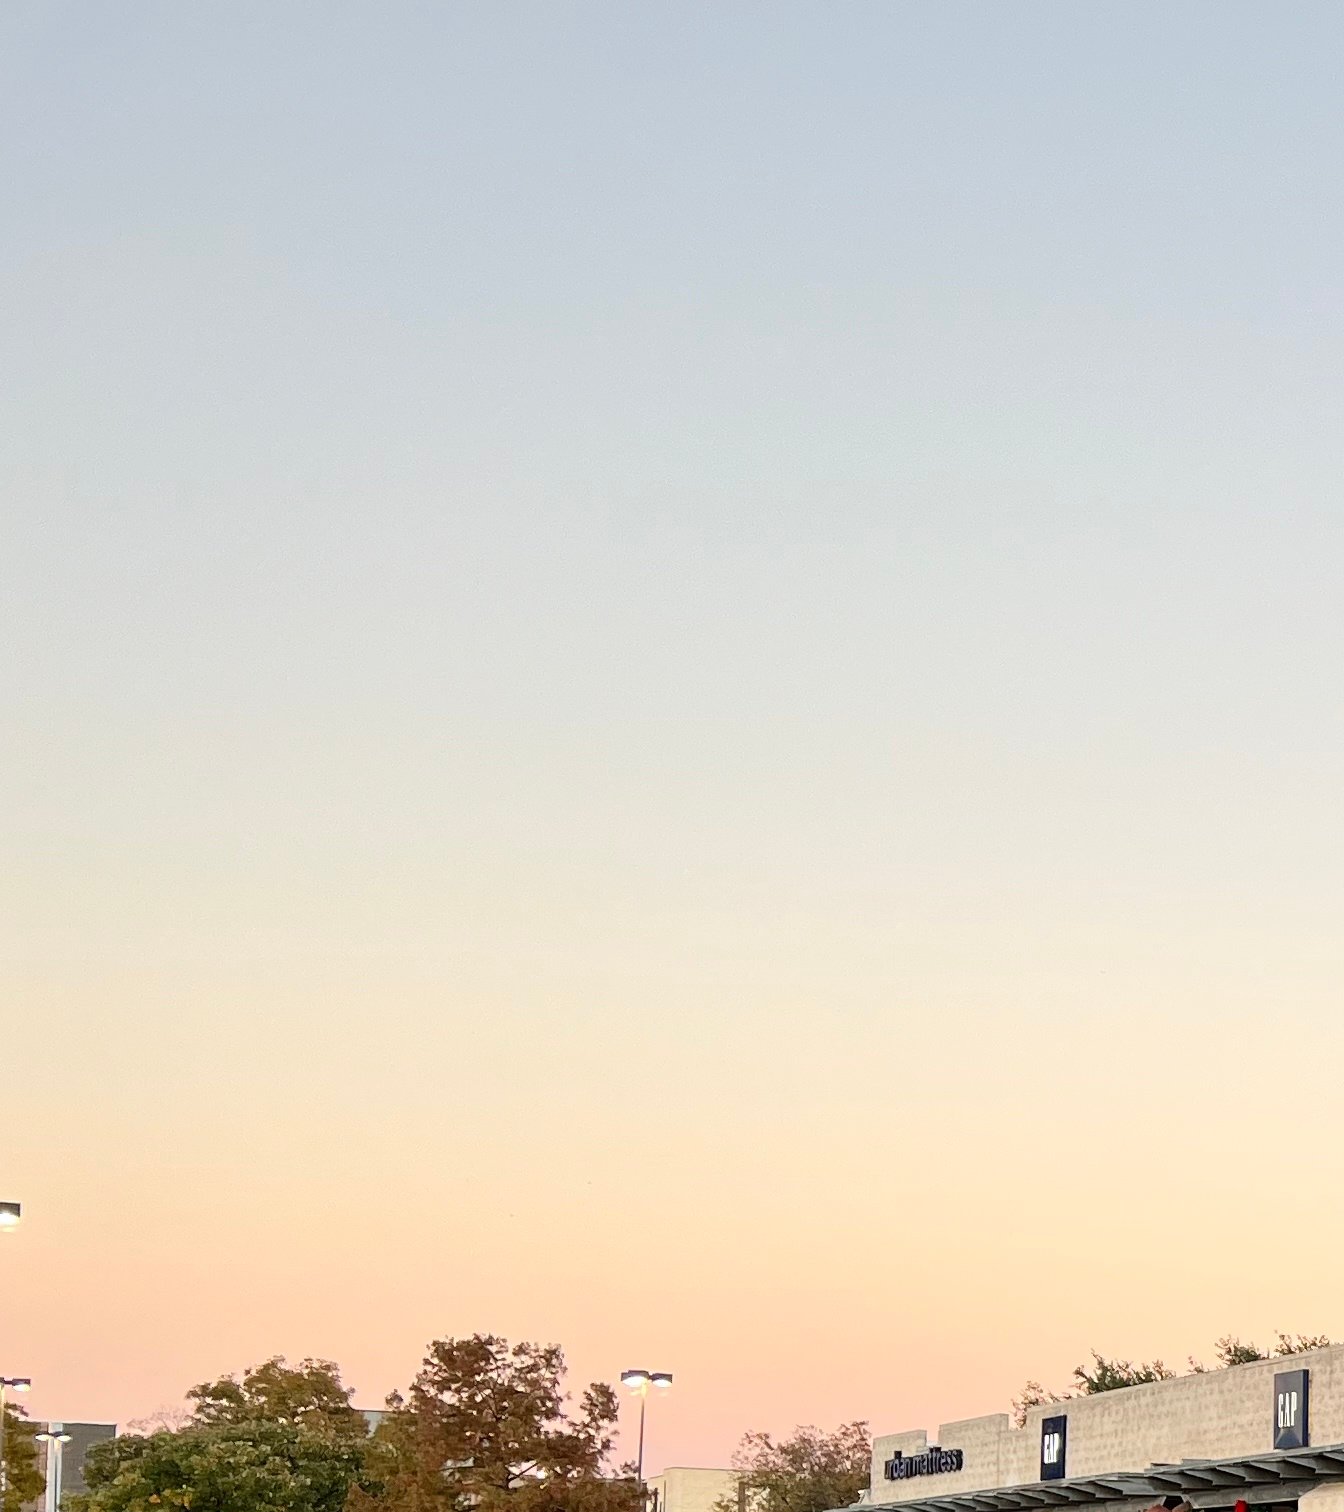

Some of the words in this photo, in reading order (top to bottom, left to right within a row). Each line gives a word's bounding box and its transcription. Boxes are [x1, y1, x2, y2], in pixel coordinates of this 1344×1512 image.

[1277, 1391, 1298, 1428] GAP
[912, 1446, 963, 1476] mattress
[1043, 1432, 1060, 1465] GAP
